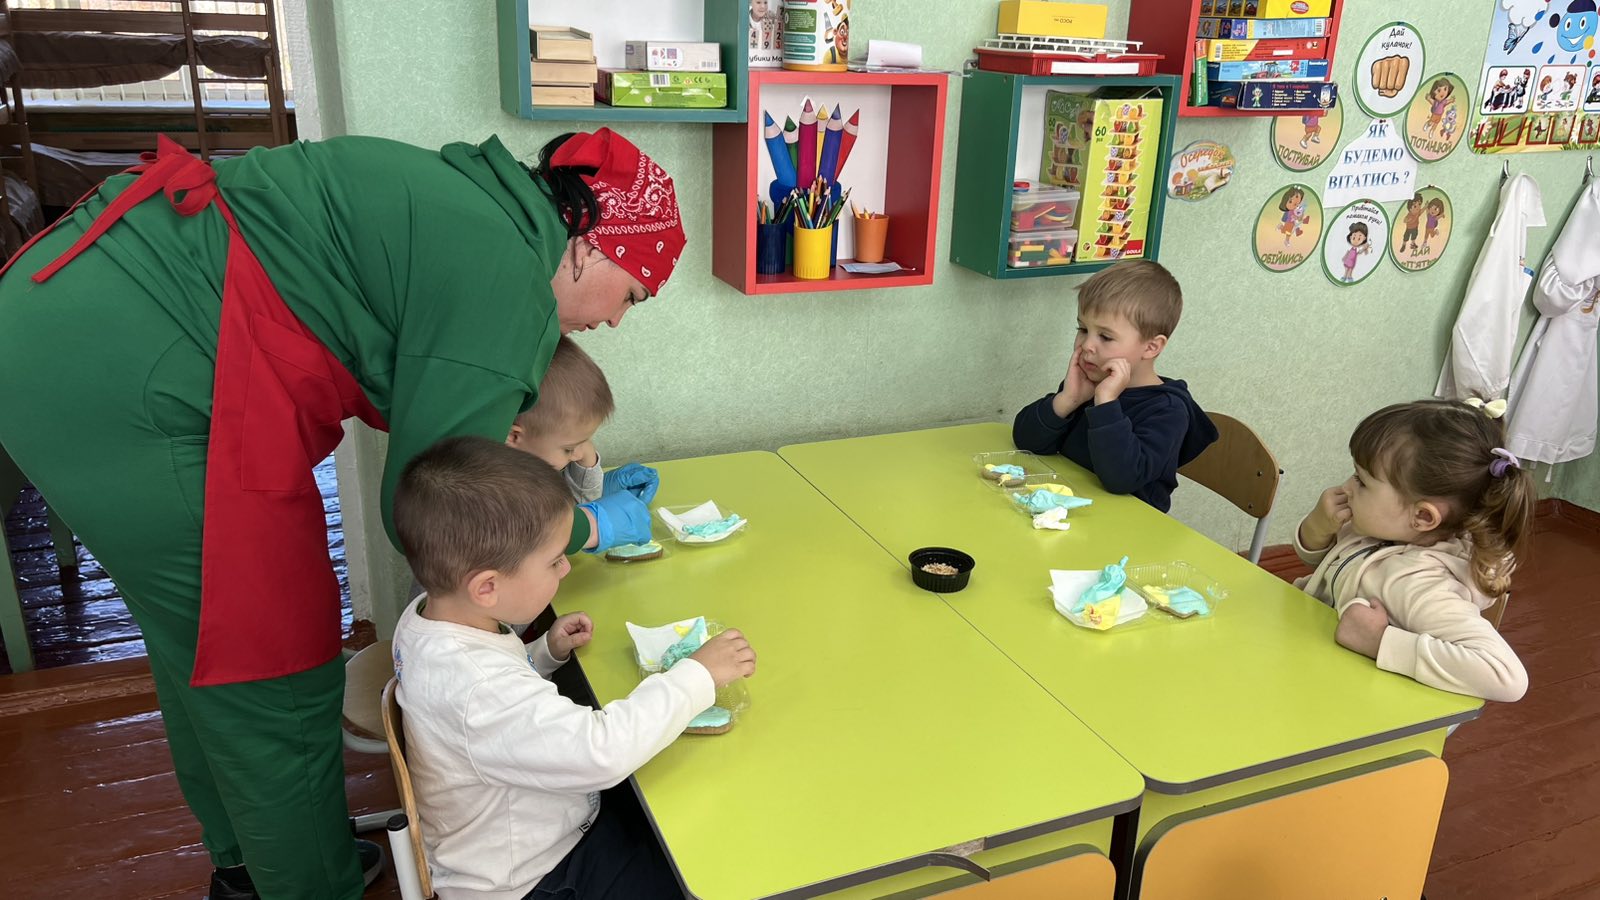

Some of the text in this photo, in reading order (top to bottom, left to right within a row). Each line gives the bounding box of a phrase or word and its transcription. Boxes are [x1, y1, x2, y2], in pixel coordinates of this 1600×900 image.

[776, 32, 781, 40] 2
[1389, 28, 1405, 38] Дай
[1382, 42, 1412, 50] кулачок!
[1095, 126, 1106, 136] 60
[1367, 124, 1389, 138] ЯК
[1411, 136, 1452, 154] ПОТАНЦЮЙ
[1180, 148, 1225, 168] Осередок
[1279, 144, 1320, 166] ПОСТРИБАЙ
[1344, 147, 1404, 166] БУДЕМО
[1328, 172, 1399, 189] ВІТАТИСЬ
[1261, 251, 1303, 265] ОБІЙМИСЬ
[1411, 246, 1430, 257] ДАЙ
